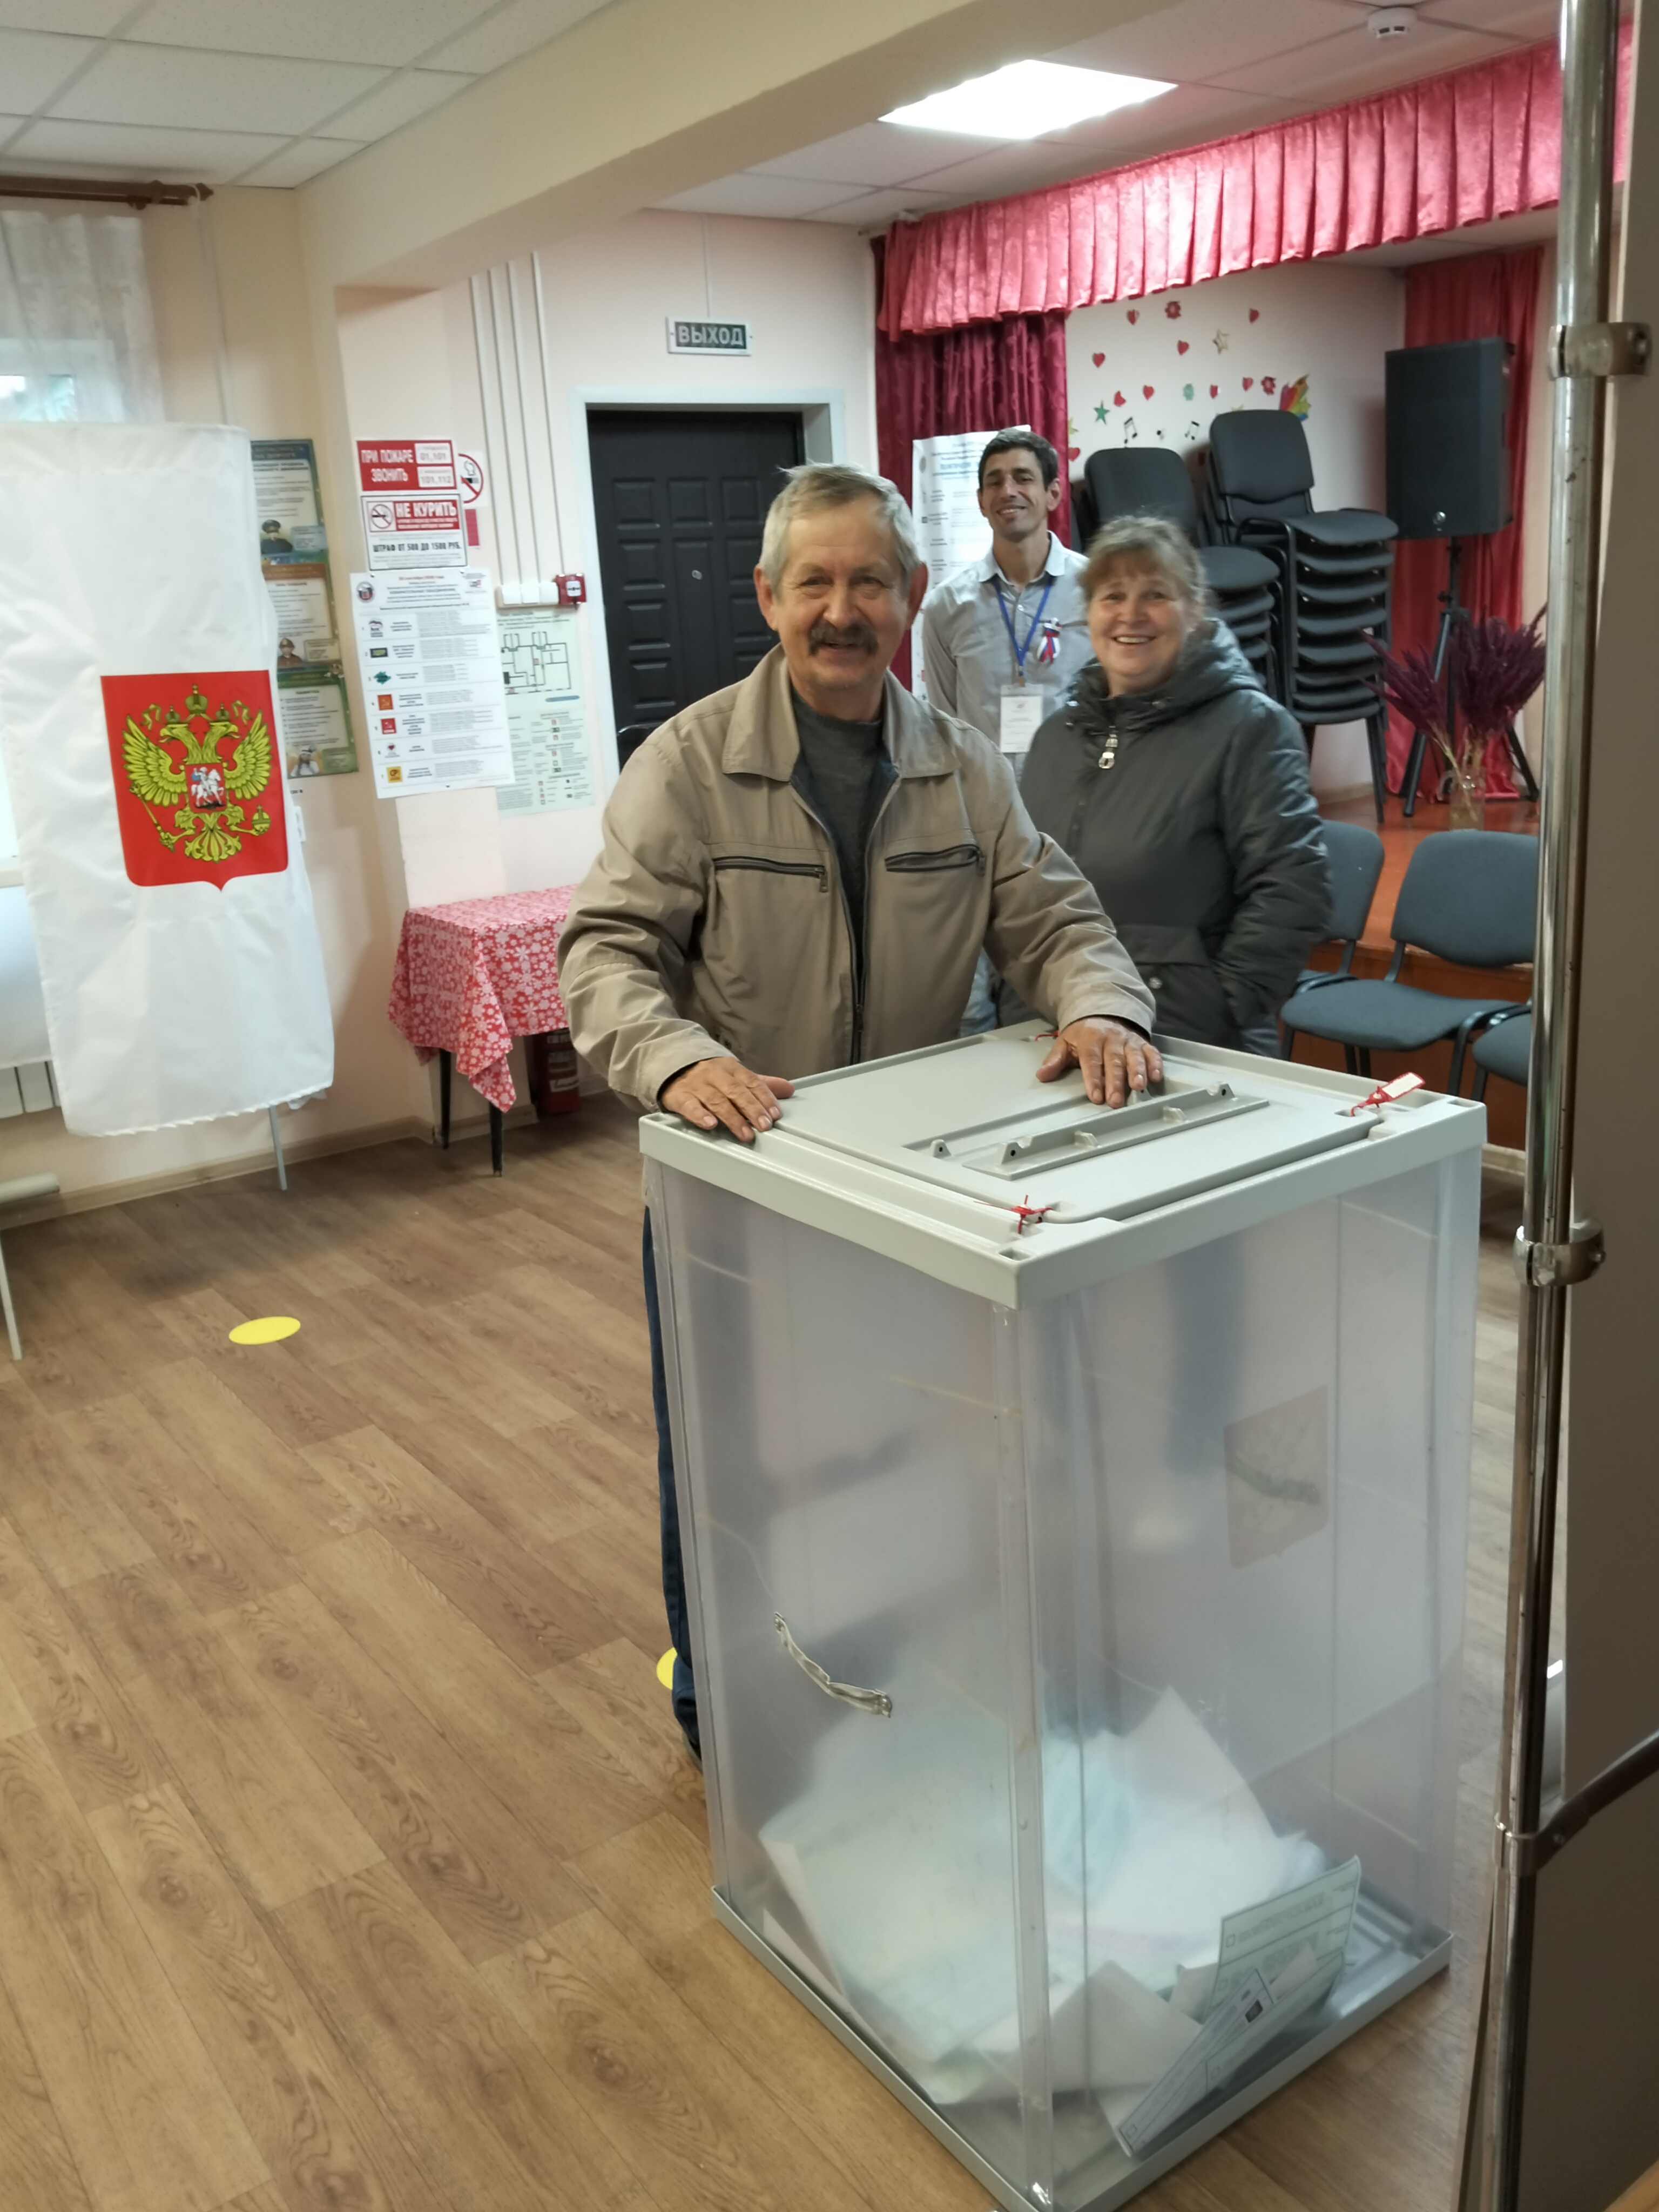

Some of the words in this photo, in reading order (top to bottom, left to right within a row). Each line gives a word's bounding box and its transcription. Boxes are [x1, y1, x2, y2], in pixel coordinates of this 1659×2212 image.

[678, 326, 744, 345] ВЫХОД
[361, 450, 379, 463] ПРИ
[380, 449, 414, 463] ПОЖАРЕ
[371, 468, 409, 482] ЗВОНИТЬ
[395, 502, 411, 517] НЕ
[413, 501, 457, 517] КУРИТЬ
